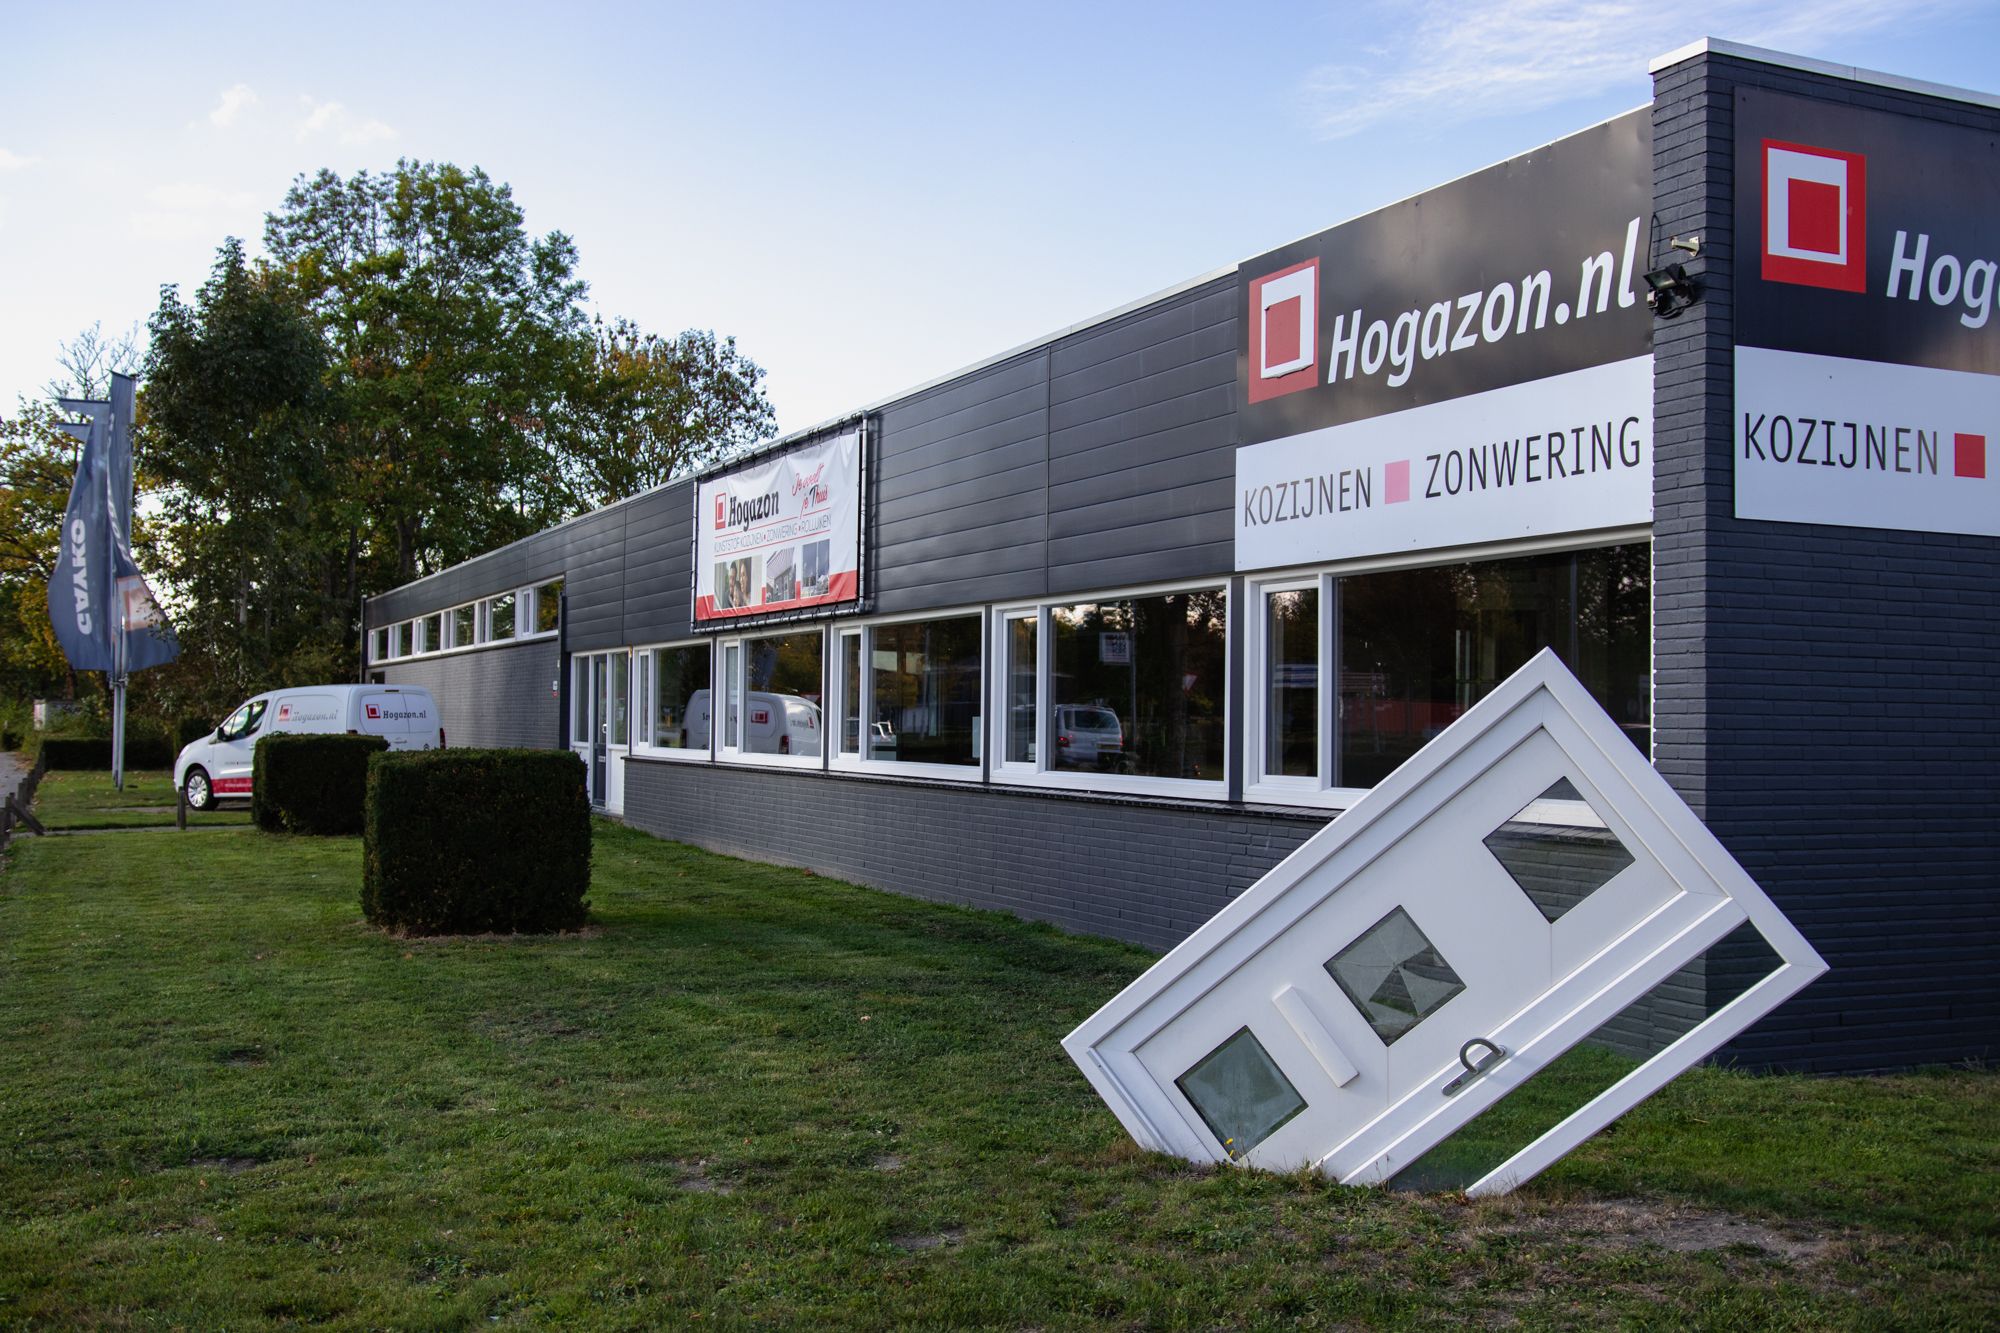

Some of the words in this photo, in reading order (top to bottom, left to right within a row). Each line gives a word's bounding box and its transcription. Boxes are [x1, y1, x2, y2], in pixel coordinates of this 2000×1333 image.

[1328, 216, 1641, 387] Hogazon.nl
[1886, 230, 2000, 329] Hog
[1244, 467, 1371, 528] KOZIJNEN
[1426, 416, 1641, 498] ZONWERING
[1745, 413, 1938, 475] KOZIJNEN
[728, 490, 779, 532] Hogazon
[766, 522, 798, 542] ZONWERING
[383, 709, 427, 720] Hogazon.nl
